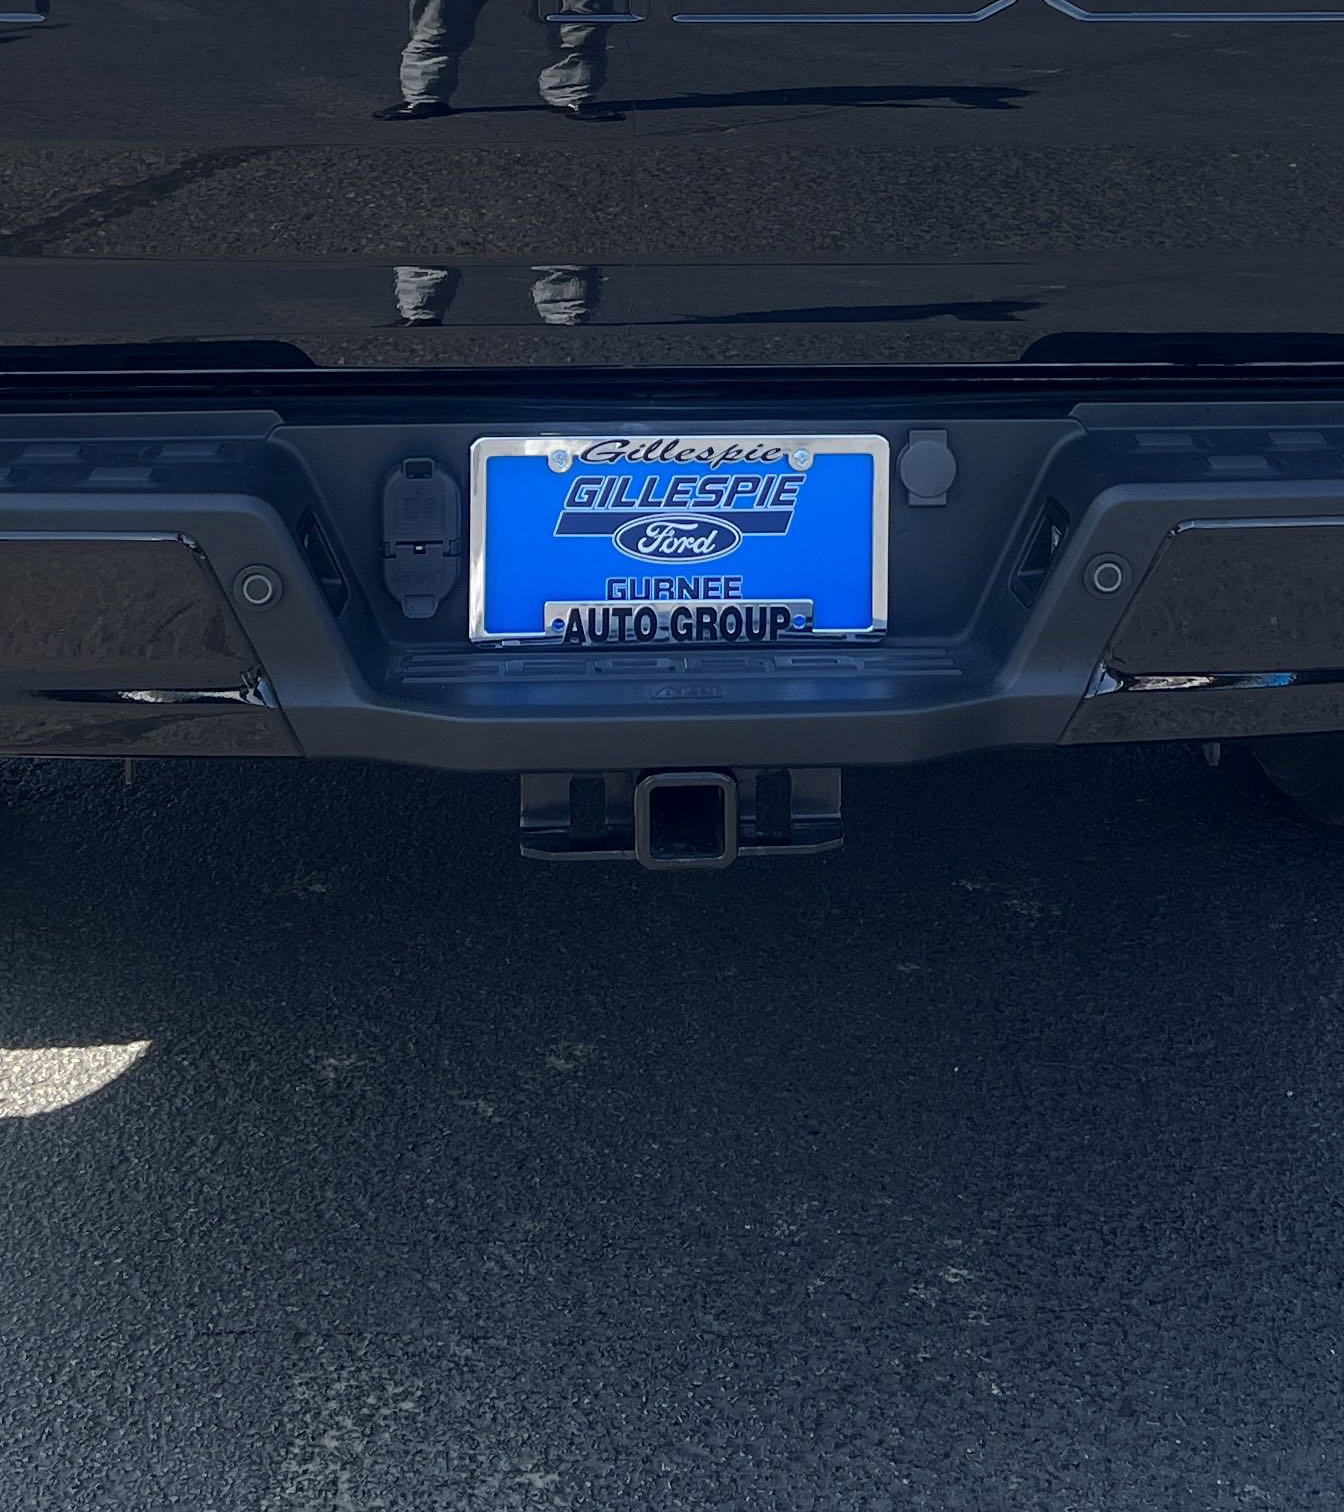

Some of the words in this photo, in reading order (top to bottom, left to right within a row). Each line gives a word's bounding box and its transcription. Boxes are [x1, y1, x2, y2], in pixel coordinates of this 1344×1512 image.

[580, 439, 784, 470] Gillespie
[564, 474, 807, 509] GILLESPIE
[637, 521, 717, 555] Ford
[606, 576, 742, 600] GURNEE
[563, 607, 658, 643] AUTO
[669, 605, 792, 642] GROUP
